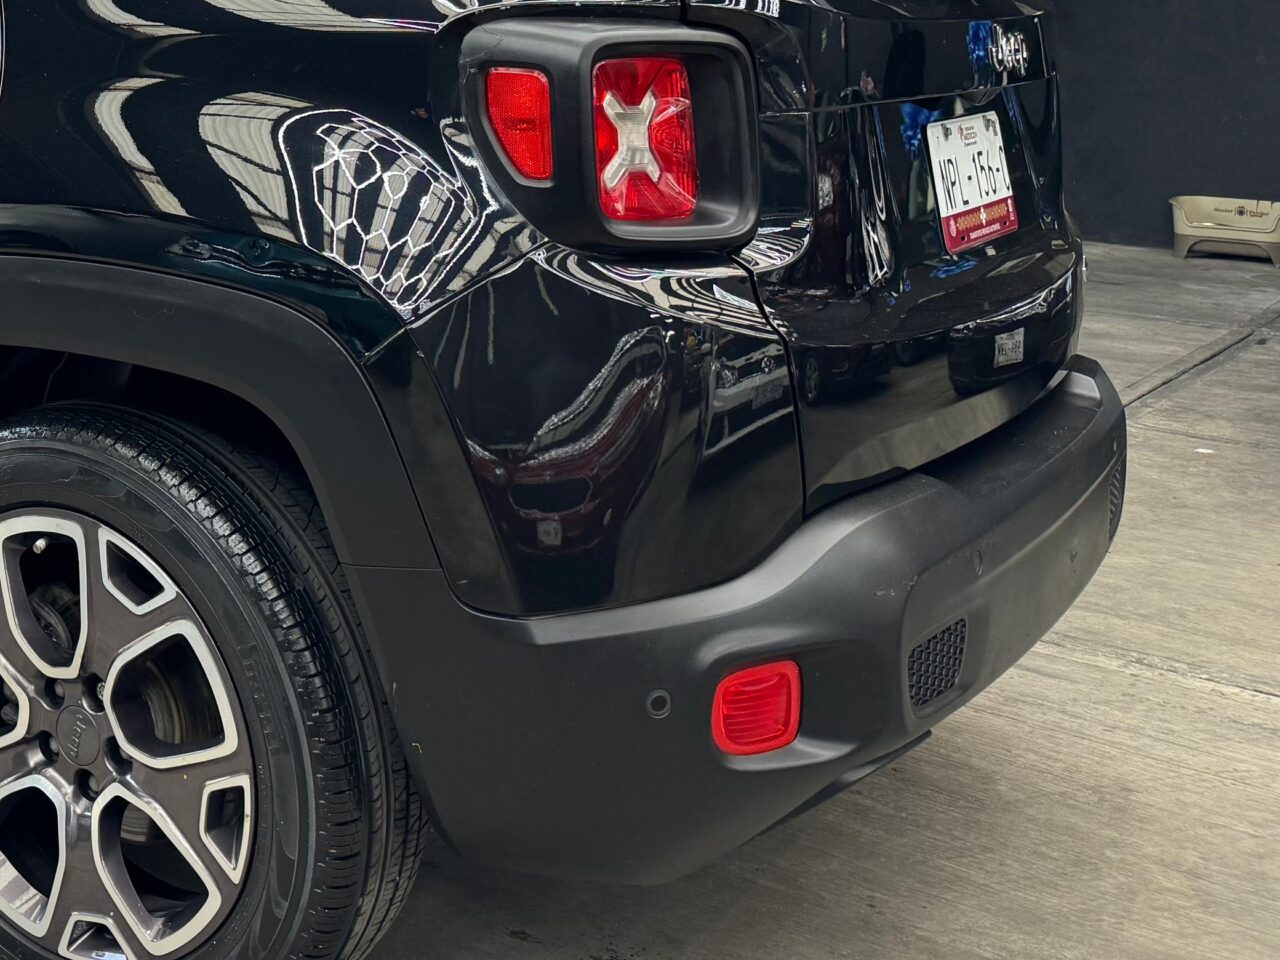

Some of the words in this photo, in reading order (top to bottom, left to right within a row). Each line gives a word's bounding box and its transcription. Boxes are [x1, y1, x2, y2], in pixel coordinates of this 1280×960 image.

[988, 23, 1028, 76] Jeep
[938, 145, 1011, 212] NPL-156-C
[66, 714, 86, 760] Jeep
